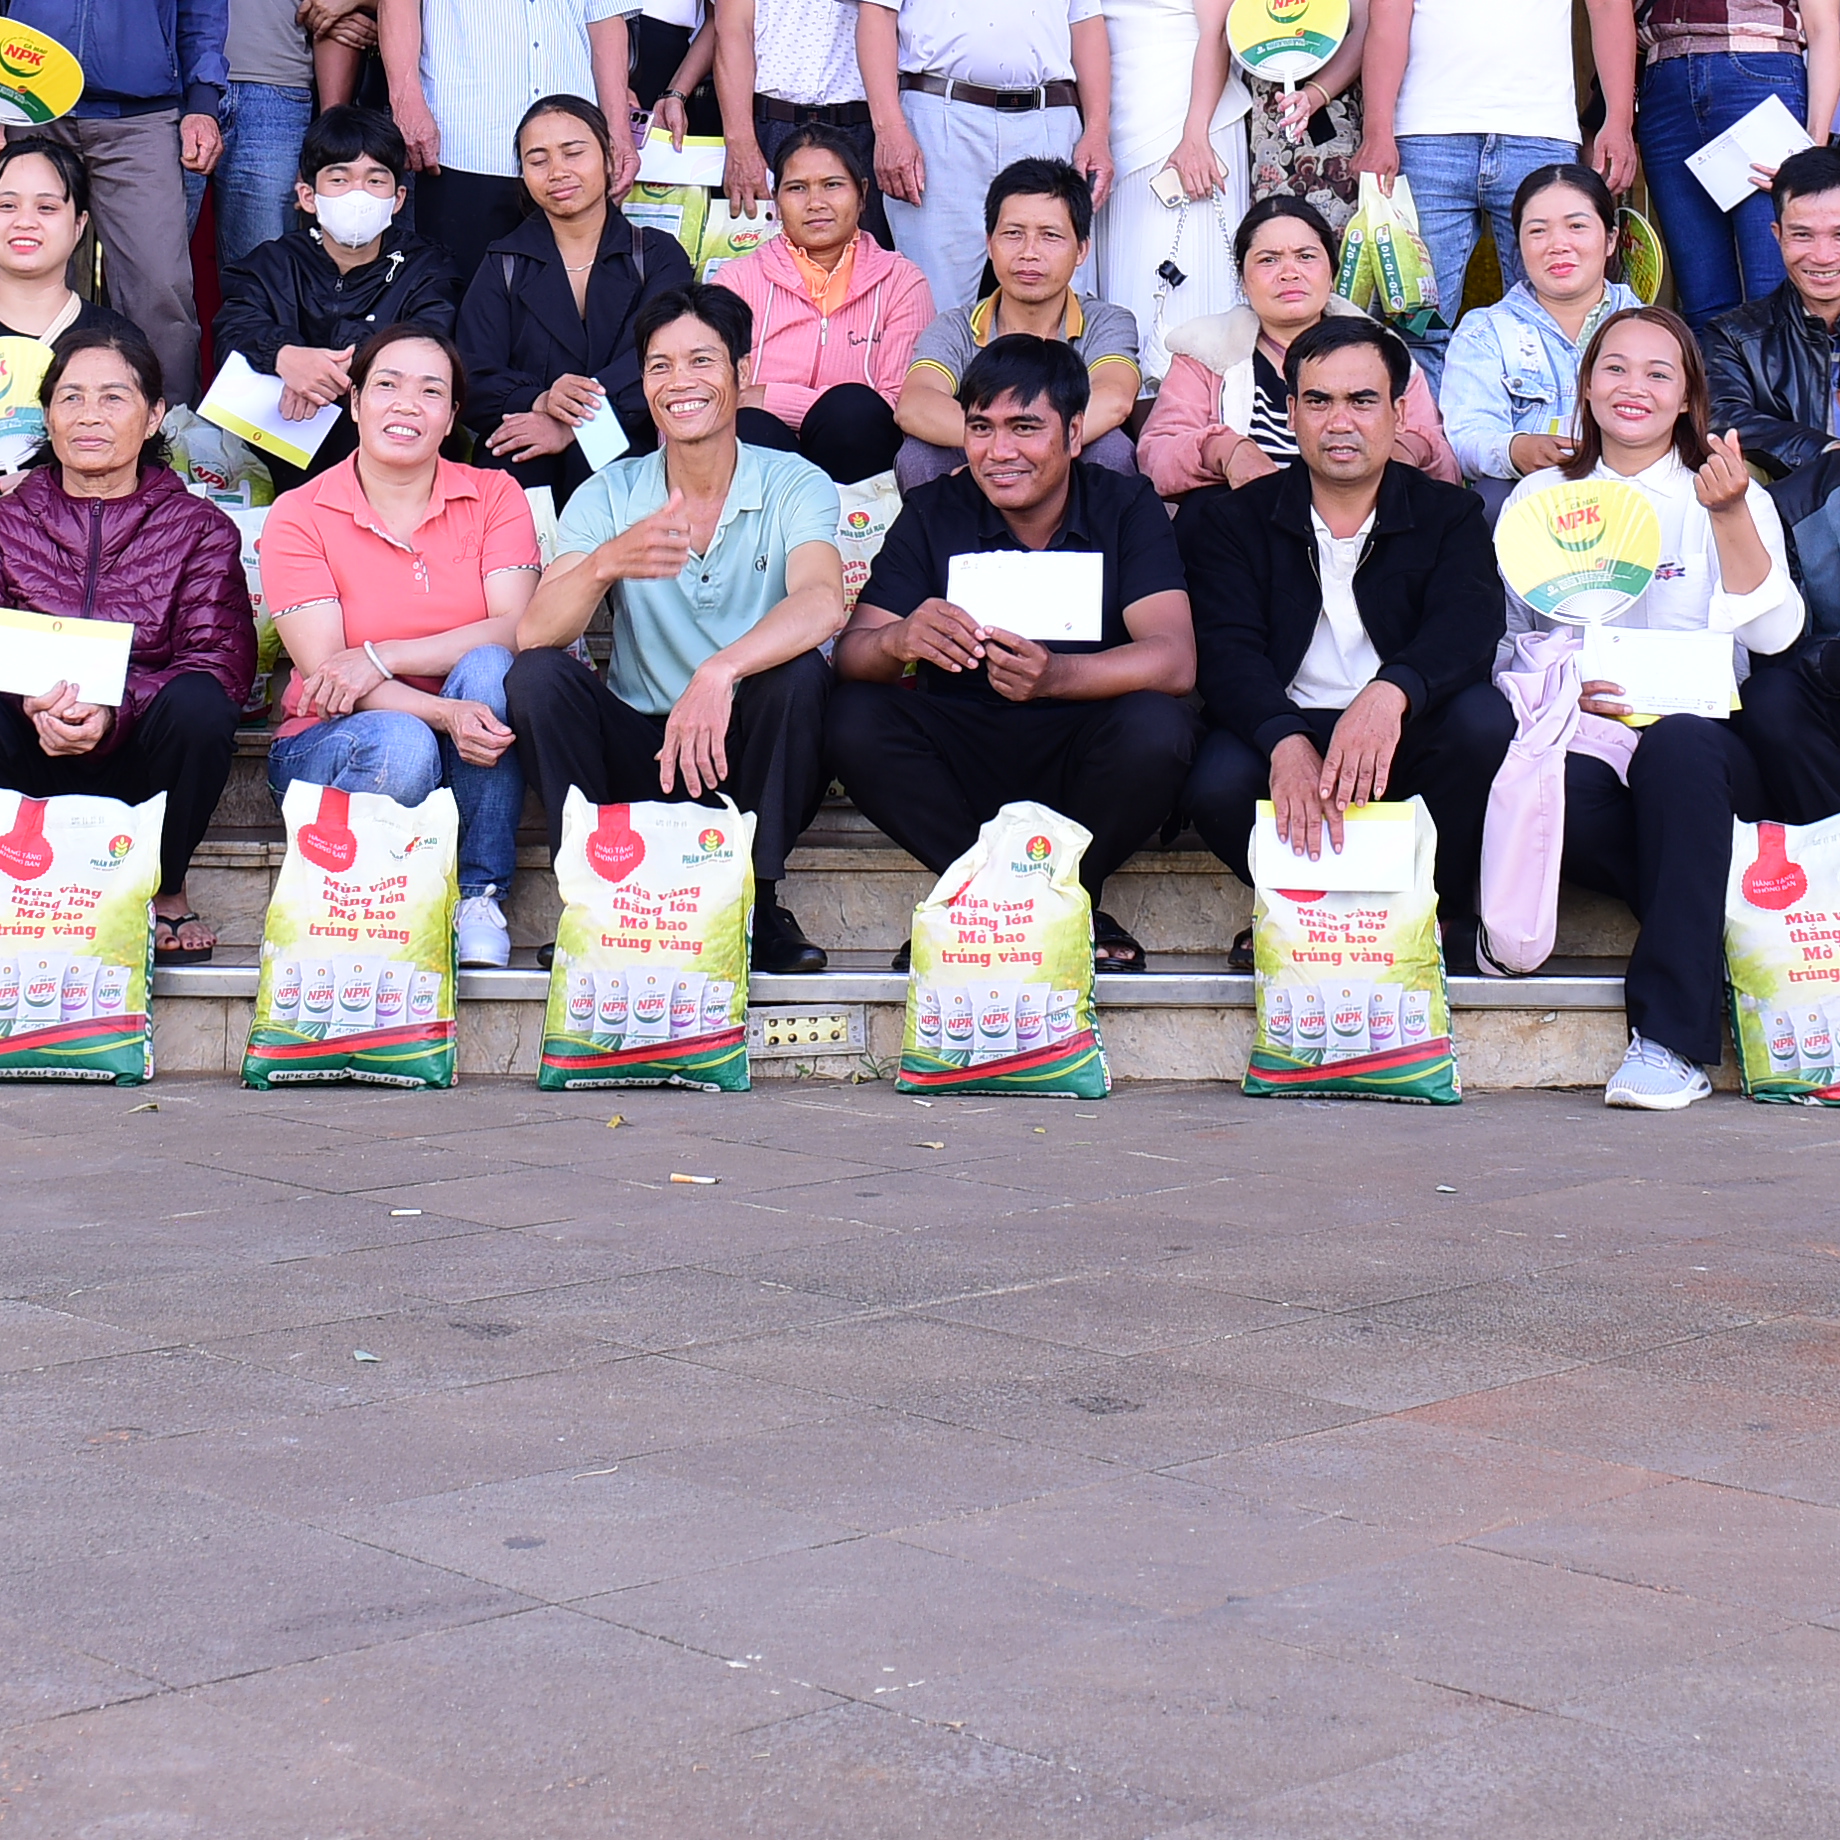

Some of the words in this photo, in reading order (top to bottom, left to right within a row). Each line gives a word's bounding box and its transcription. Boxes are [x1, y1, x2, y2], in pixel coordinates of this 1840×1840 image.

[4, 43, 46, 68] NPK
[732, 231, 761, 242] NPK
[1339, 244, 1356, 296] 20-10-10
[1381, 245, 1400, 294] 20-10-10
[1556, 505, 1601, 533] NPK
[369, 875, 407, 892] vàng
[60, 884, 102, 898] vàng
[380, 891, 405, 904] lớn
[658, 886, 700, 901] vàng
[68, 896, 96, 908] lớn
[670, 900, 697, 912] lớn
[993, 898, 1034, 912] vàng
[52, 910, 83, 920] bao
[363, 909, 396, 920] bao
[1006, 914, 1033, 924] lớn
[1344, 906, 1388, 919] vàng
[1784, 909, 1827, 925] Mùa
[53, 921, 97, 940] vàng
[655, 917, 688, 931] bao
[1358, 918, 1386, 931] lớn
[309, 922, 359, 941] trúng
[366, 924, 410, 944] vàng
[994, 932, 1025, 943] bao
[1345, 930, 1377, 944] bao
[601, 931, 651, 953] trúng
[659, 935, 703, 955] vàng
[942, 948, 991, 967] trúng
[998, 948, 1043, 966] vàng
[1292, 948, 1342, 966] trúng
[1350, 947, 1394, 967] vàng
[1788, 964, 1840, 983] trúng
